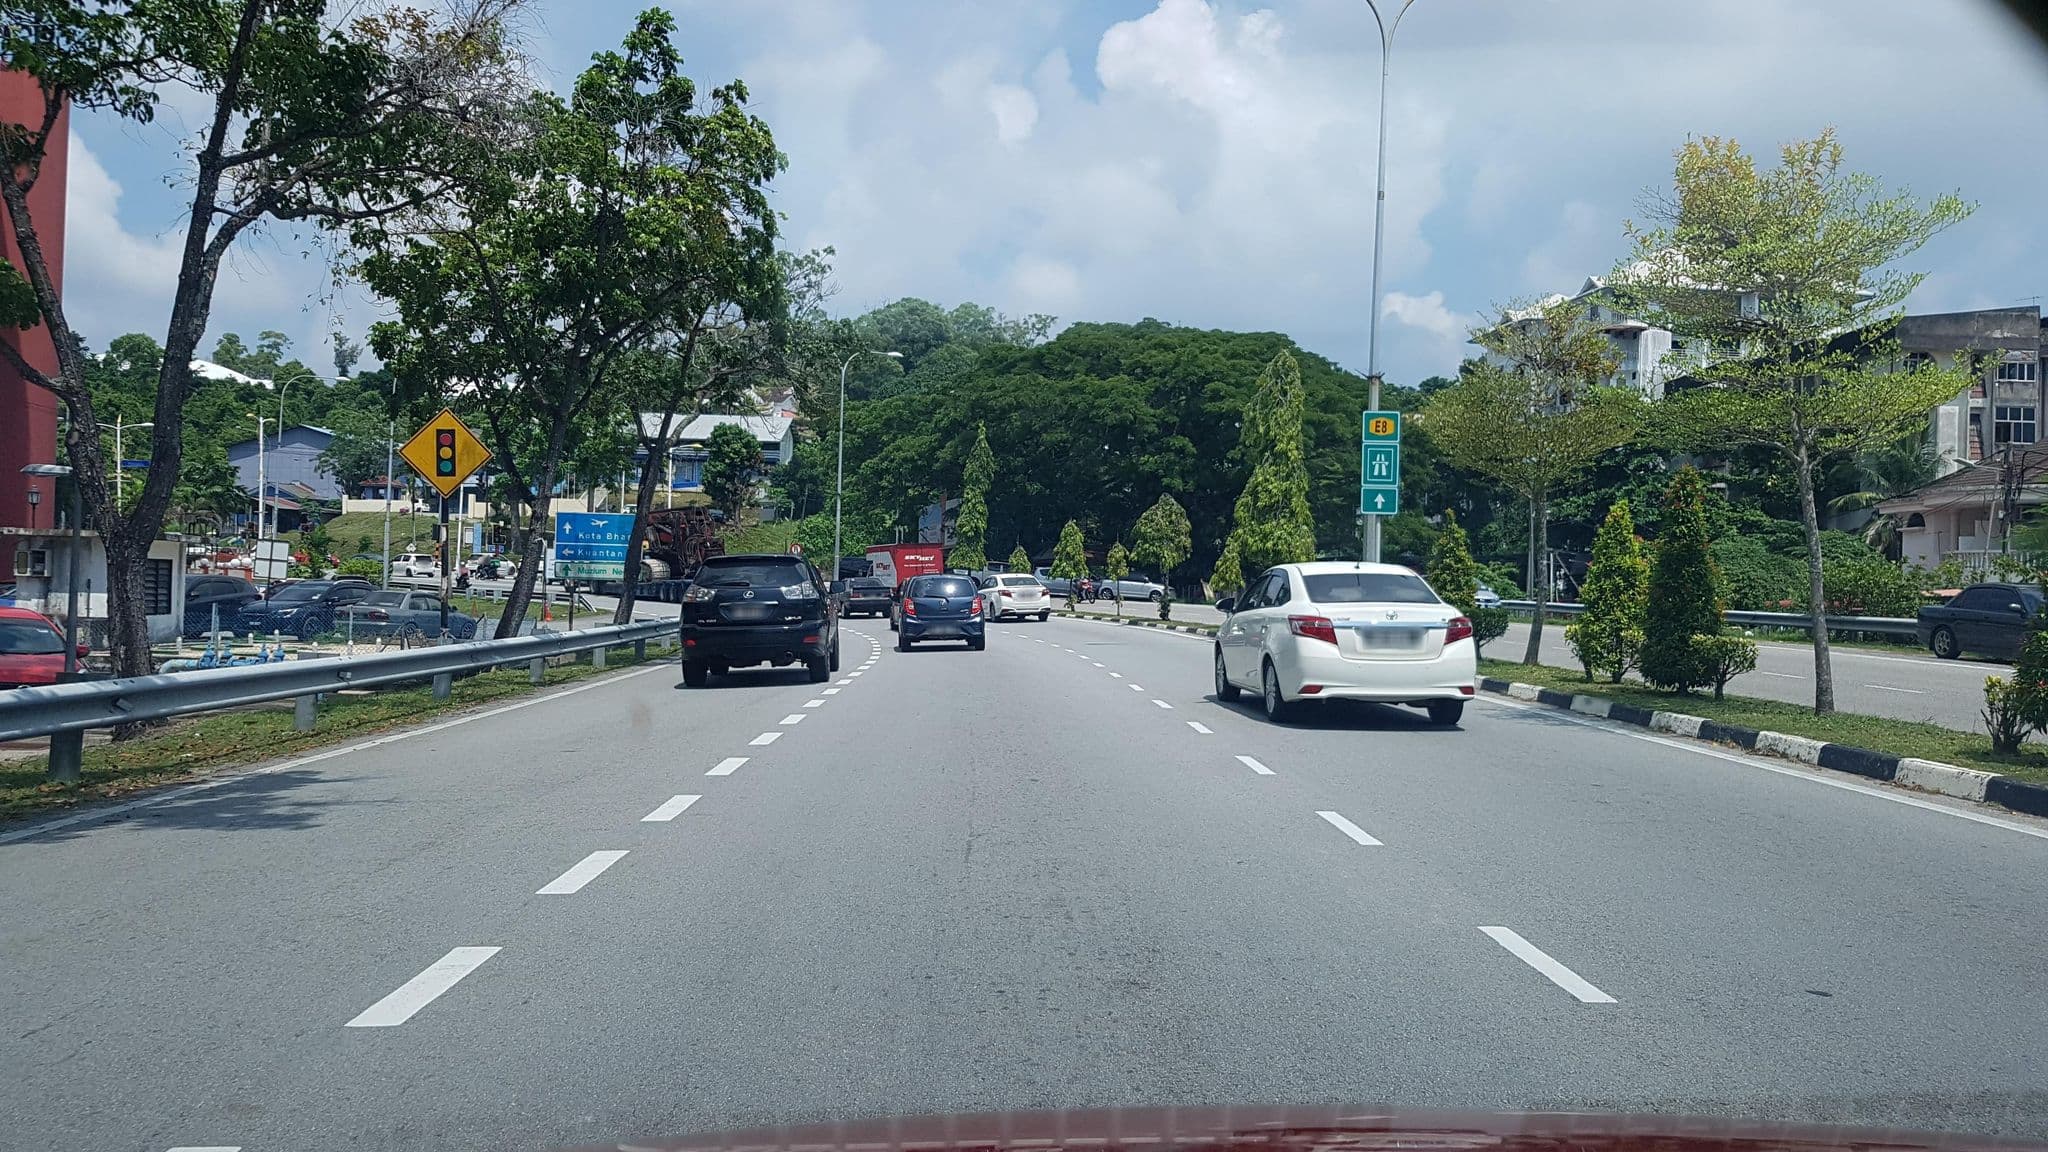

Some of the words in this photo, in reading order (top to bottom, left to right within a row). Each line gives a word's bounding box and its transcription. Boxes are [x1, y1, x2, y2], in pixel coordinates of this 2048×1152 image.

[1375, 420, 1387, 433] E8
[578, 532, 601, 540] Kota
[578, 549, 622, 557] Kuantan
